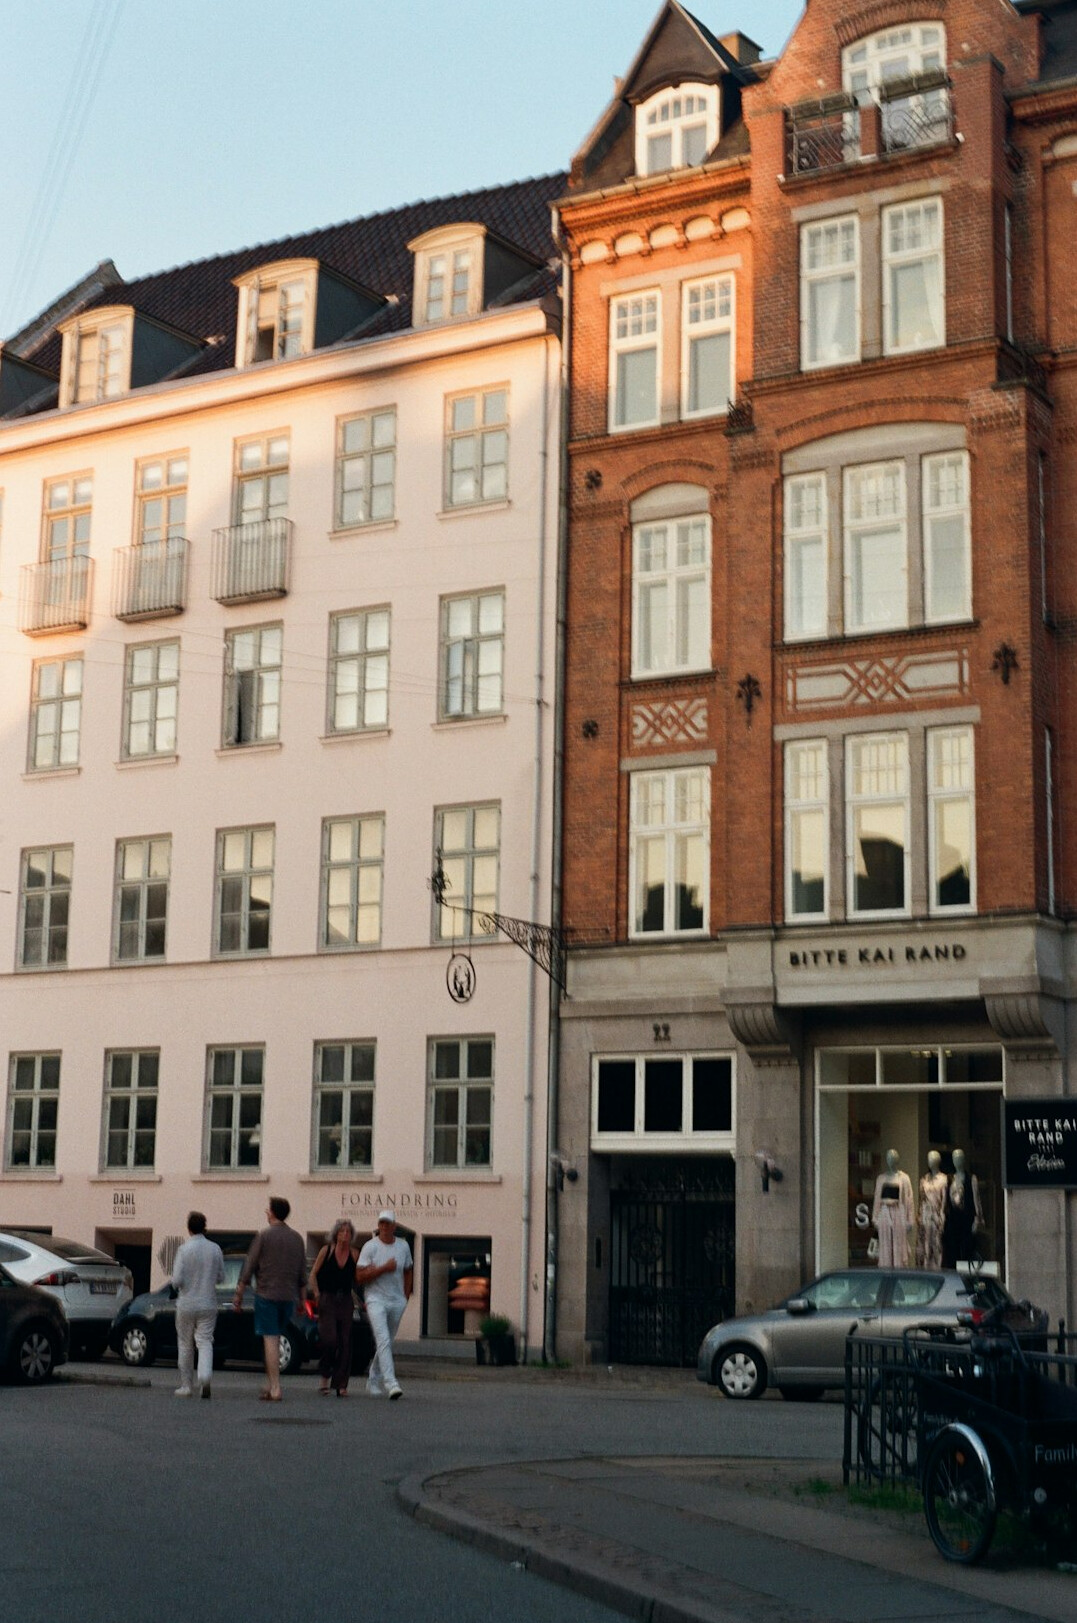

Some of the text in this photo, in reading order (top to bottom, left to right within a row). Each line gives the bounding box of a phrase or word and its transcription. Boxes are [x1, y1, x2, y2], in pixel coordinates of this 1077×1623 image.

[789, 943, 967, 966] BITTE KAI RAND
[1014, 1117, 1077, 1132] BITTE KAI
[1028, 1131, 1064, 1145] RAND
[113, 1192, 136, 1205] DAHL
[341, 1192, 458, 1208] FORANDRING
[112, 1206, 136, 1215] STUDIO
